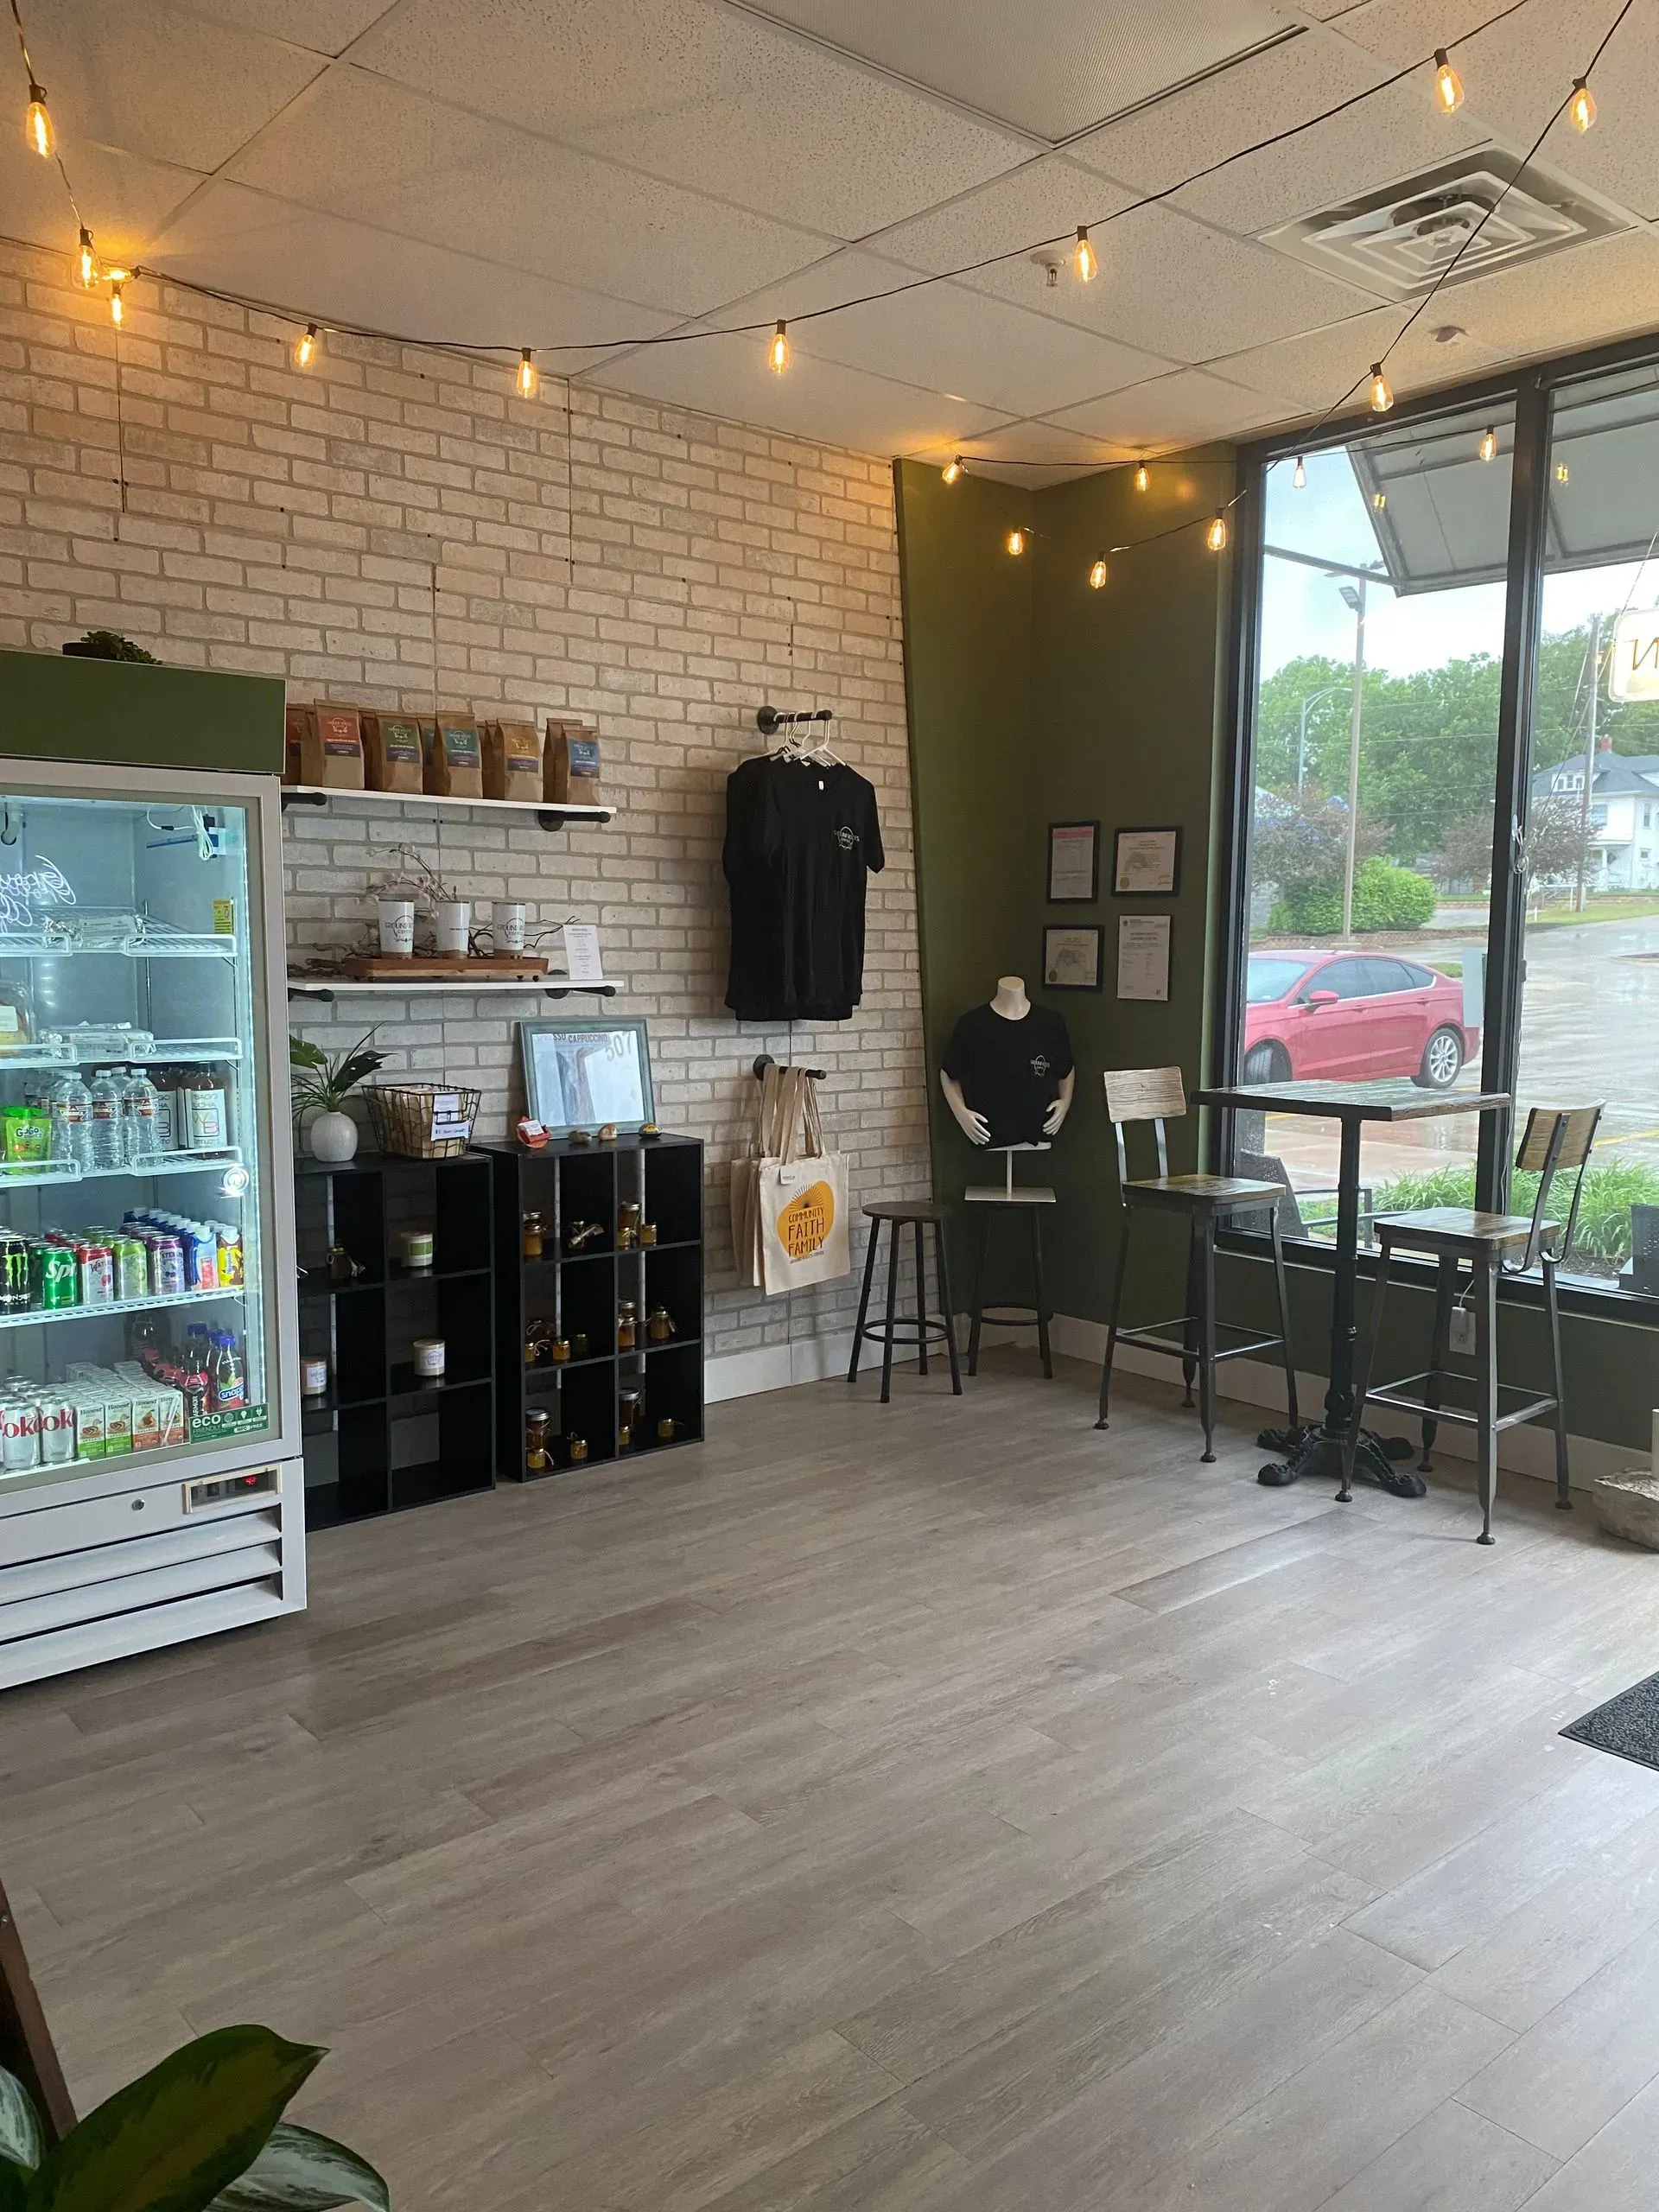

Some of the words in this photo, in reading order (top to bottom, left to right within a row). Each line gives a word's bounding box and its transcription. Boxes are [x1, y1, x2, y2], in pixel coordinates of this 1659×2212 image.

[788, 1206, 824, 1224] COMMUNITY
[788, 1217, 824, 1242] FAITH
[787, 1236, 824, 1257] FAMILY
[192, 1414, 221, 1428] eco
